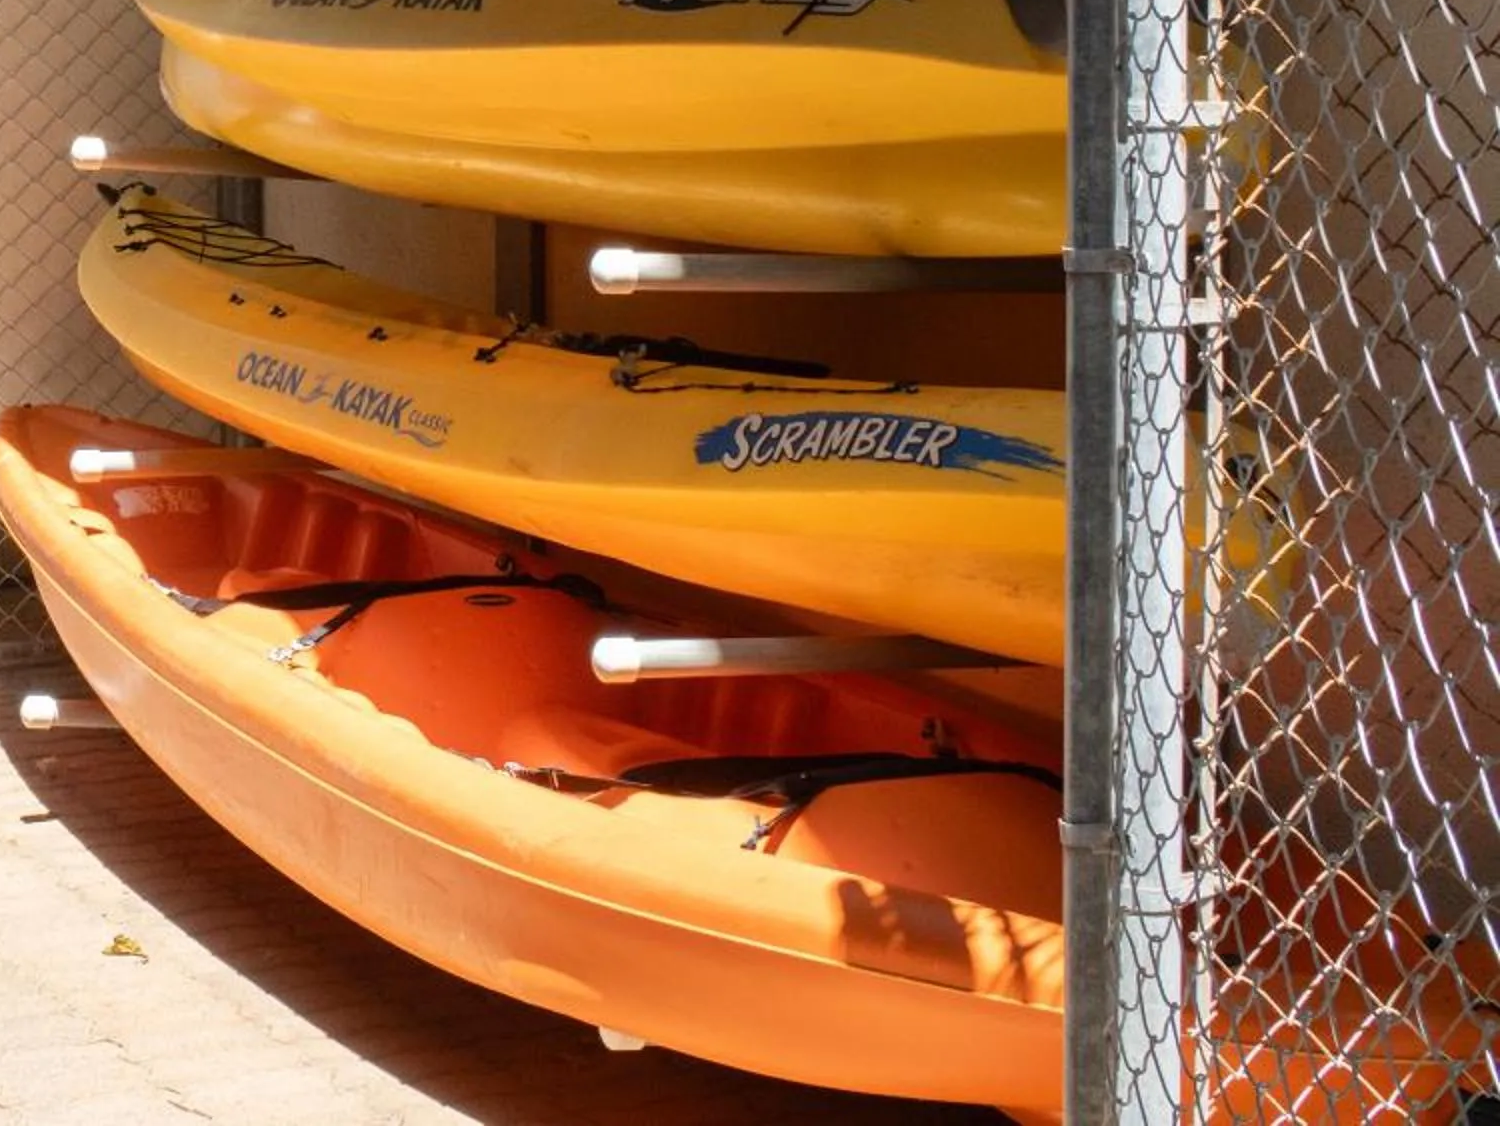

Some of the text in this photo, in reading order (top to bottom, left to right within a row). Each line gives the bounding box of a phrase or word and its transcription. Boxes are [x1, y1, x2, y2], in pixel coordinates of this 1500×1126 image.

[237, 352, 307, 396] OCEAN
[331, 379, 412, 429] KAYAK
[723, 412, 958, 472] SCRAMBLER
